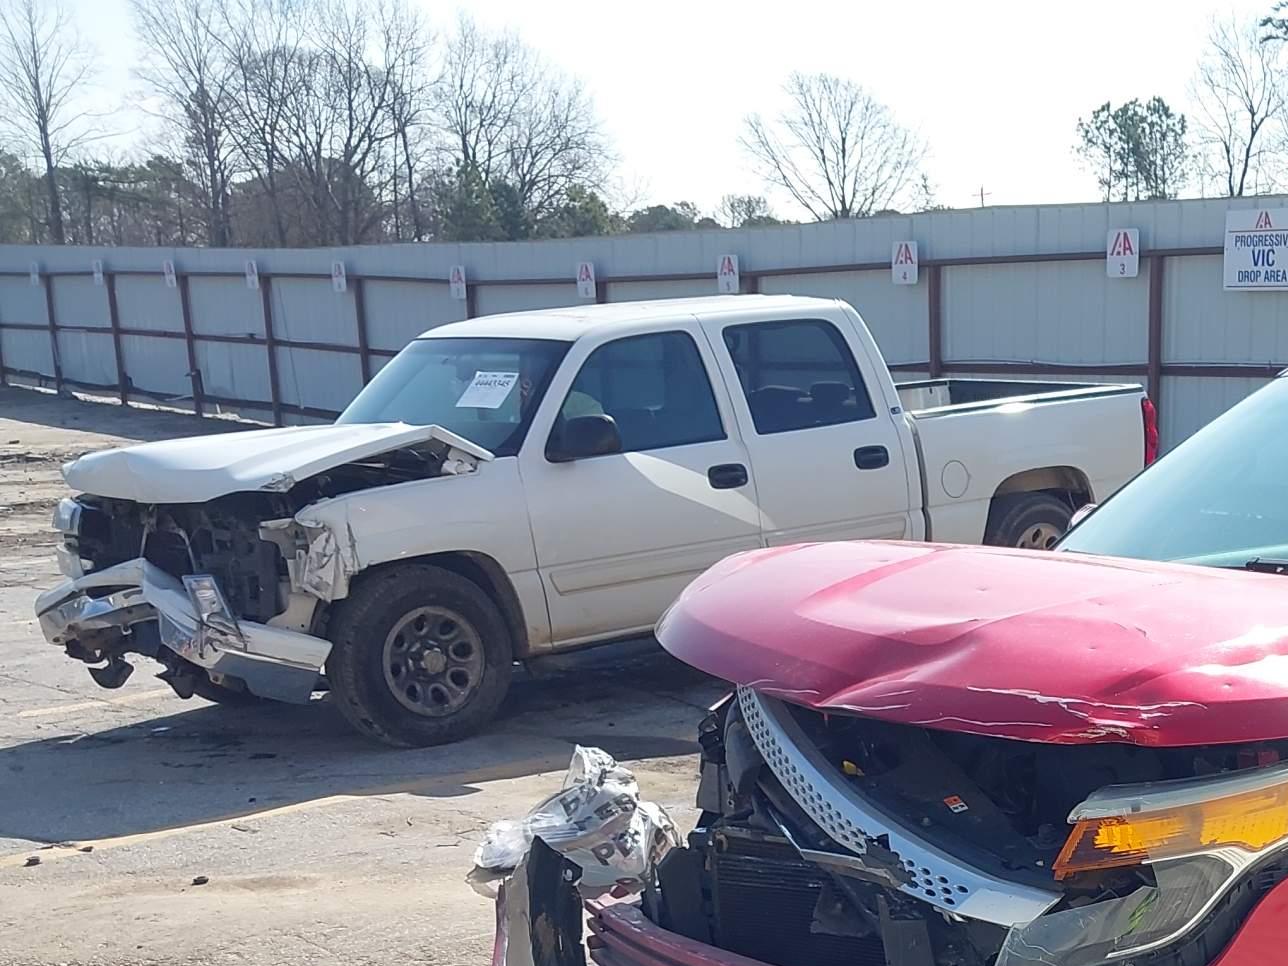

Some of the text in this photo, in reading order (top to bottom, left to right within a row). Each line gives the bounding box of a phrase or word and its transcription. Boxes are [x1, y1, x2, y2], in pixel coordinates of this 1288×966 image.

[1251, 248, 1276, 267] VIC
[1119, 263, 1126, 275] 3
[1237, 269, 1288, 283] DROP AREA
